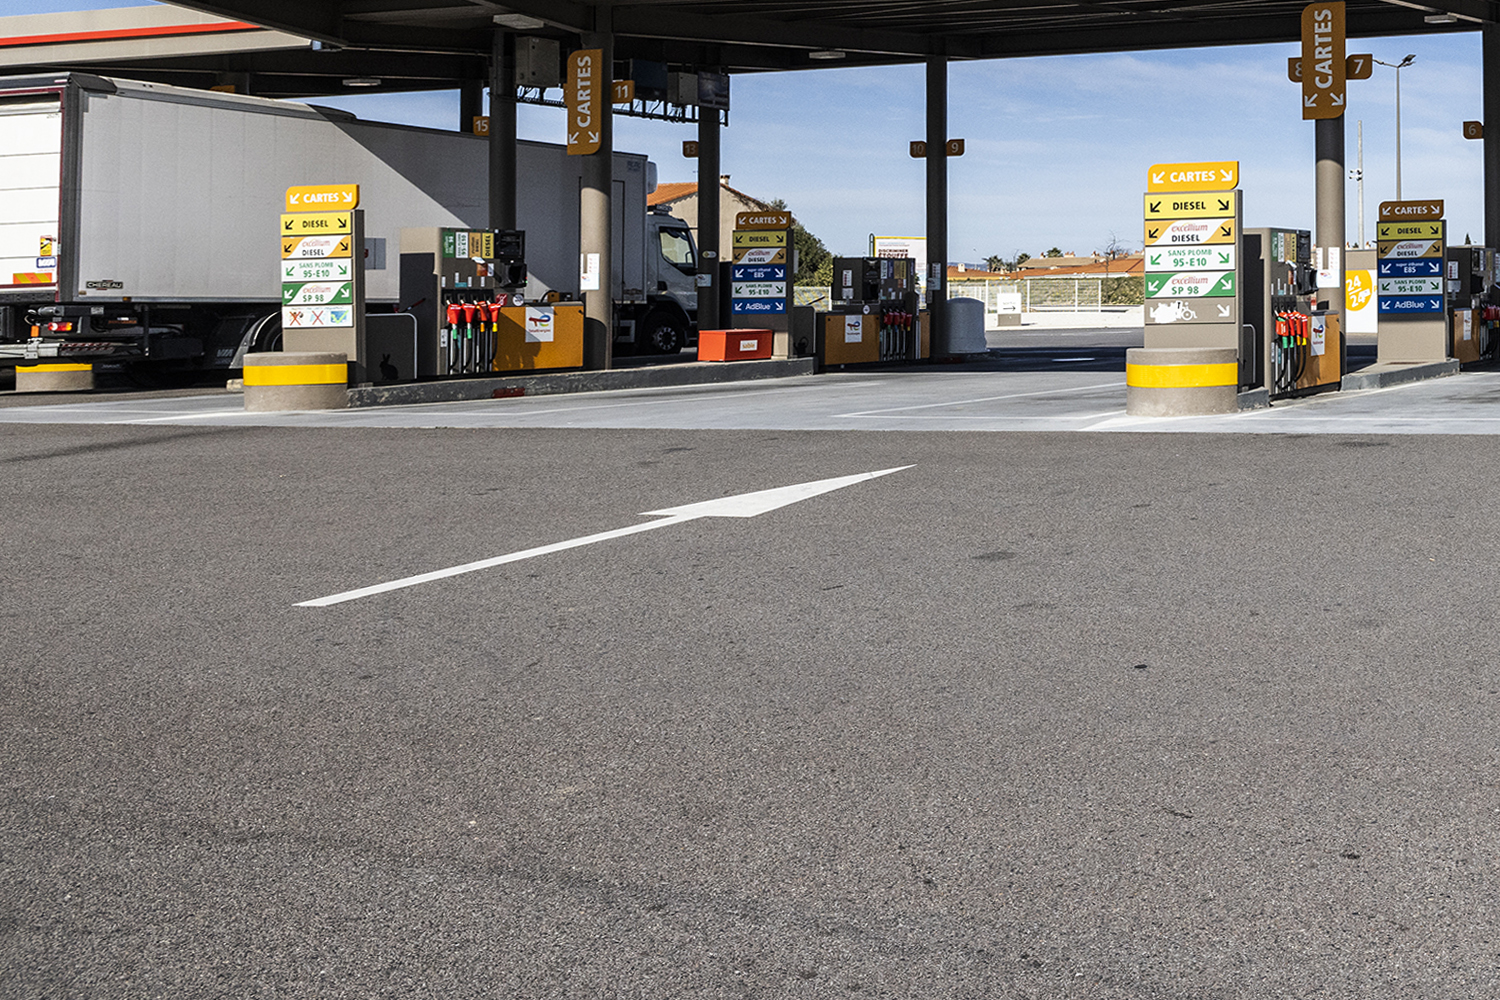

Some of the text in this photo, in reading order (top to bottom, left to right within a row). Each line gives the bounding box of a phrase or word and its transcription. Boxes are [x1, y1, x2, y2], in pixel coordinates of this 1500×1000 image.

[1314, 8, 1333, 89] CARTES
[1353, 59, 1364, 75] 7
[577, 55, 592, 128] CARTES
[615, 85, 629, 98] 11
[475, 120, 489, 132] 15
[1468, 124, 1477, 136] 6
[685, 144, 696, 154] 13
[912, 144, 924, 155] 10
[951, 142, 959, 153] 9
[1170, 170, 1216, 183] CARTES
[303, 192, 339, 203] CARTES
[1172, 201, 1207, 211] DIESEL
[1394, 205, 1428, 215] CARTES
[302, 219, 329, 229] DIESEL
[748, 216, 777, 225] CARTES
[1171, 222, 1208, 233] excellium
[1397, 227, 1422, 235] DIESEL
[1171, 234, 1200, 242] DIESEL
[1167, 249, 1186, 257] SANS
[1171, 275, 1209, 285] excellium
[1346, 275, 1361, 292] 24
[1171, 286, 1199, 295] SP 98
[302, 294, 324, 302] SP 98
